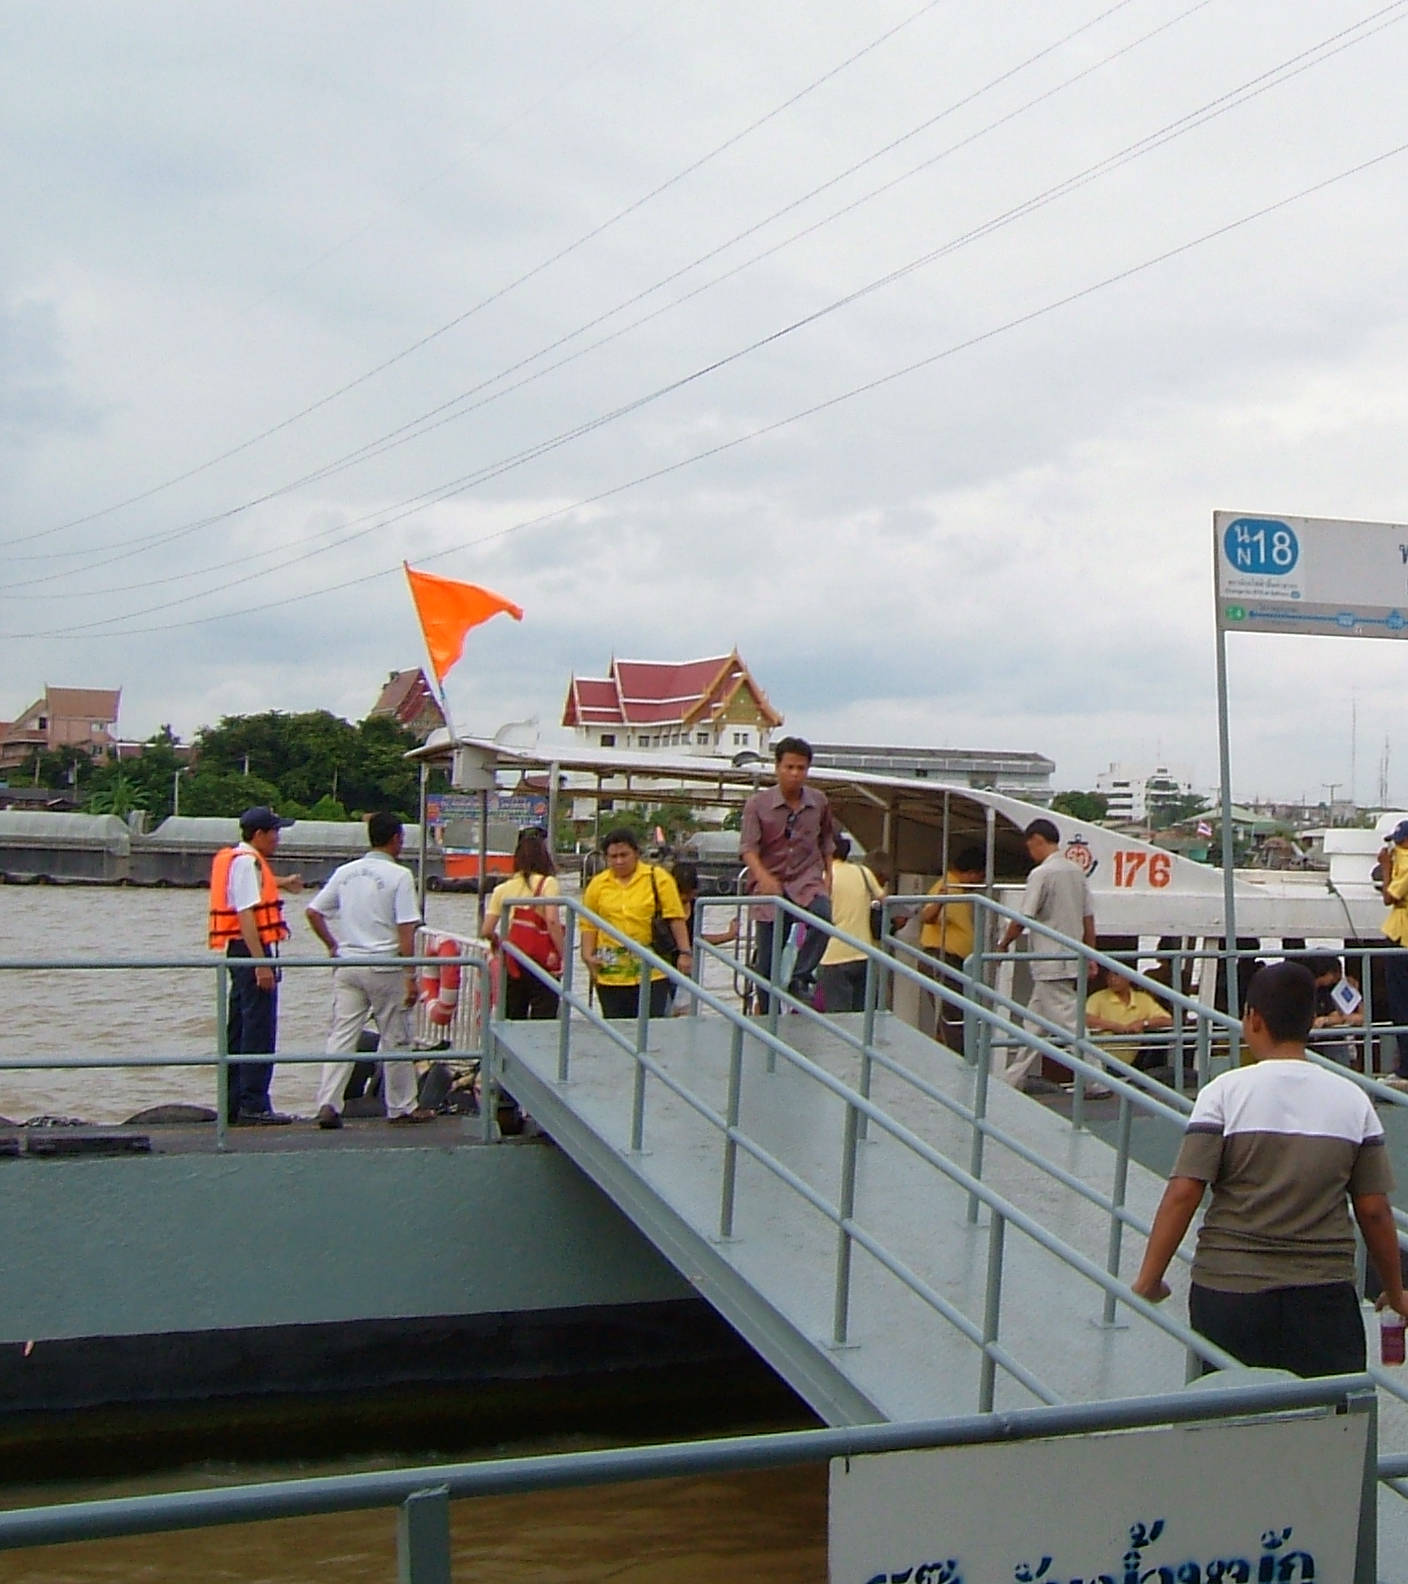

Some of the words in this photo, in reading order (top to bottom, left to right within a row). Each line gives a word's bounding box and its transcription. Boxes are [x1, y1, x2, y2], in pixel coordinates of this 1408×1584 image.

[1235, 525, 1250, 543] น
[1253, 529, 1292, 566] 18
[1237, 547, 1251, 566] N
[1114, 852, 1171, 887] 176
